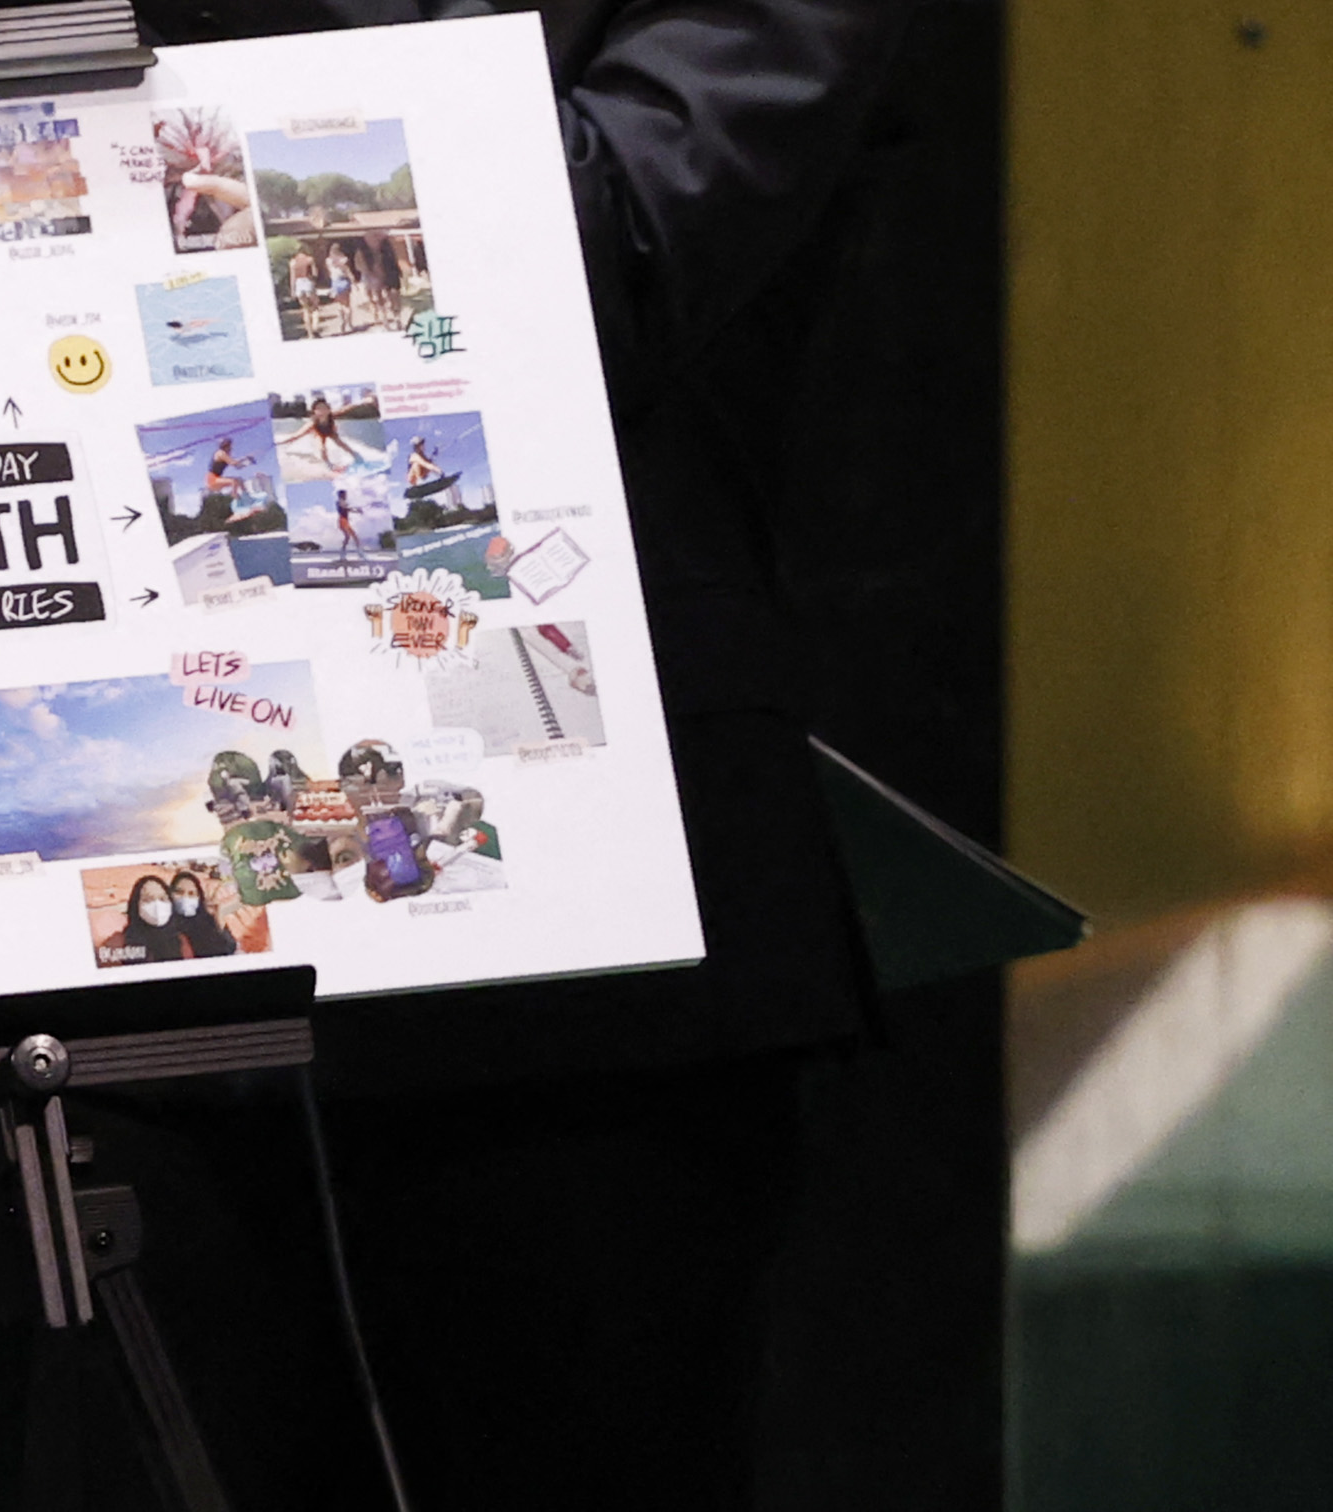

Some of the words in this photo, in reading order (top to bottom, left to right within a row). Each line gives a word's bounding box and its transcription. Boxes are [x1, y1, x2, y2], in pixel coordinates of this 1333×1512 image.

[390, 631, 448, 651] EVER
[194, 686, 247, 713] LIVE
[251, 698, 293, 728] ON
